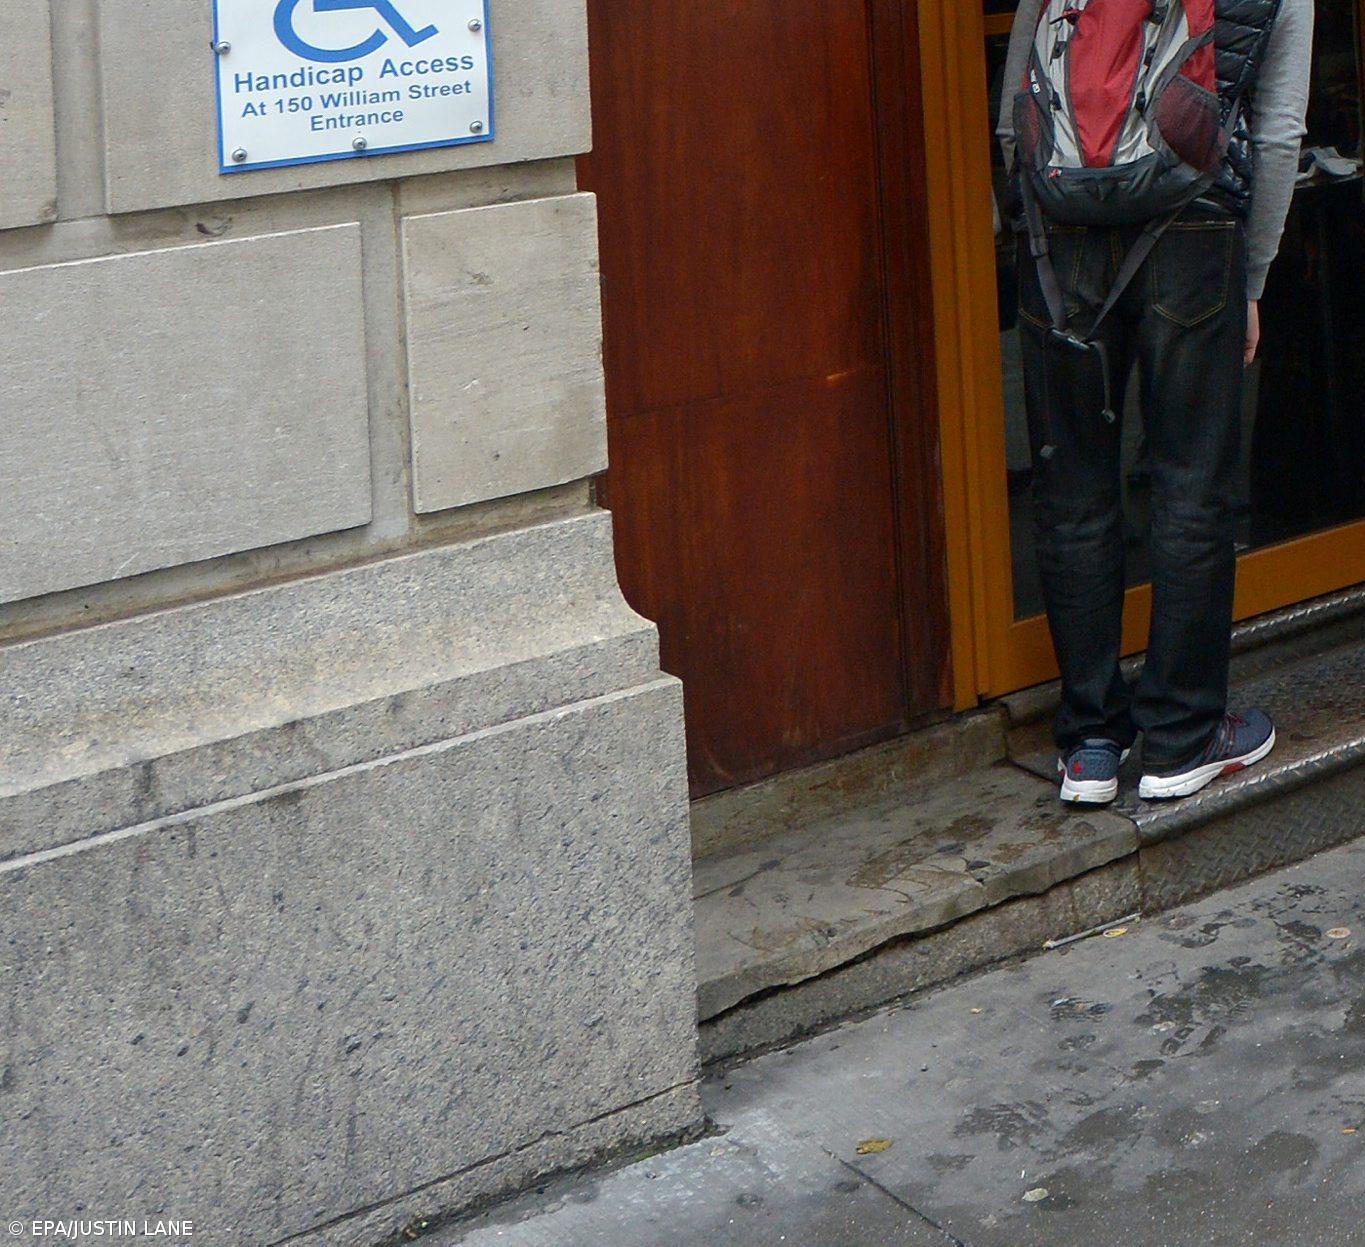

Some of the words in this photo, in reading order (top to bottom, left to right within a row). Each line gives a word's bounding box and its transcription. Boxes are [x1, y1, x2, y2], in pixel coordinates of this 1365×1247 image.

[234, 64, 364, 93] Handicap
[378, 54, 475, 79] Access
[241, 101, 267, 118] At
[274, 95, 313, 114] 150
[320, 89, 401, 109] William
[408, 80, 472, 100] Street
[310, 109, 404, 132] Entrance
